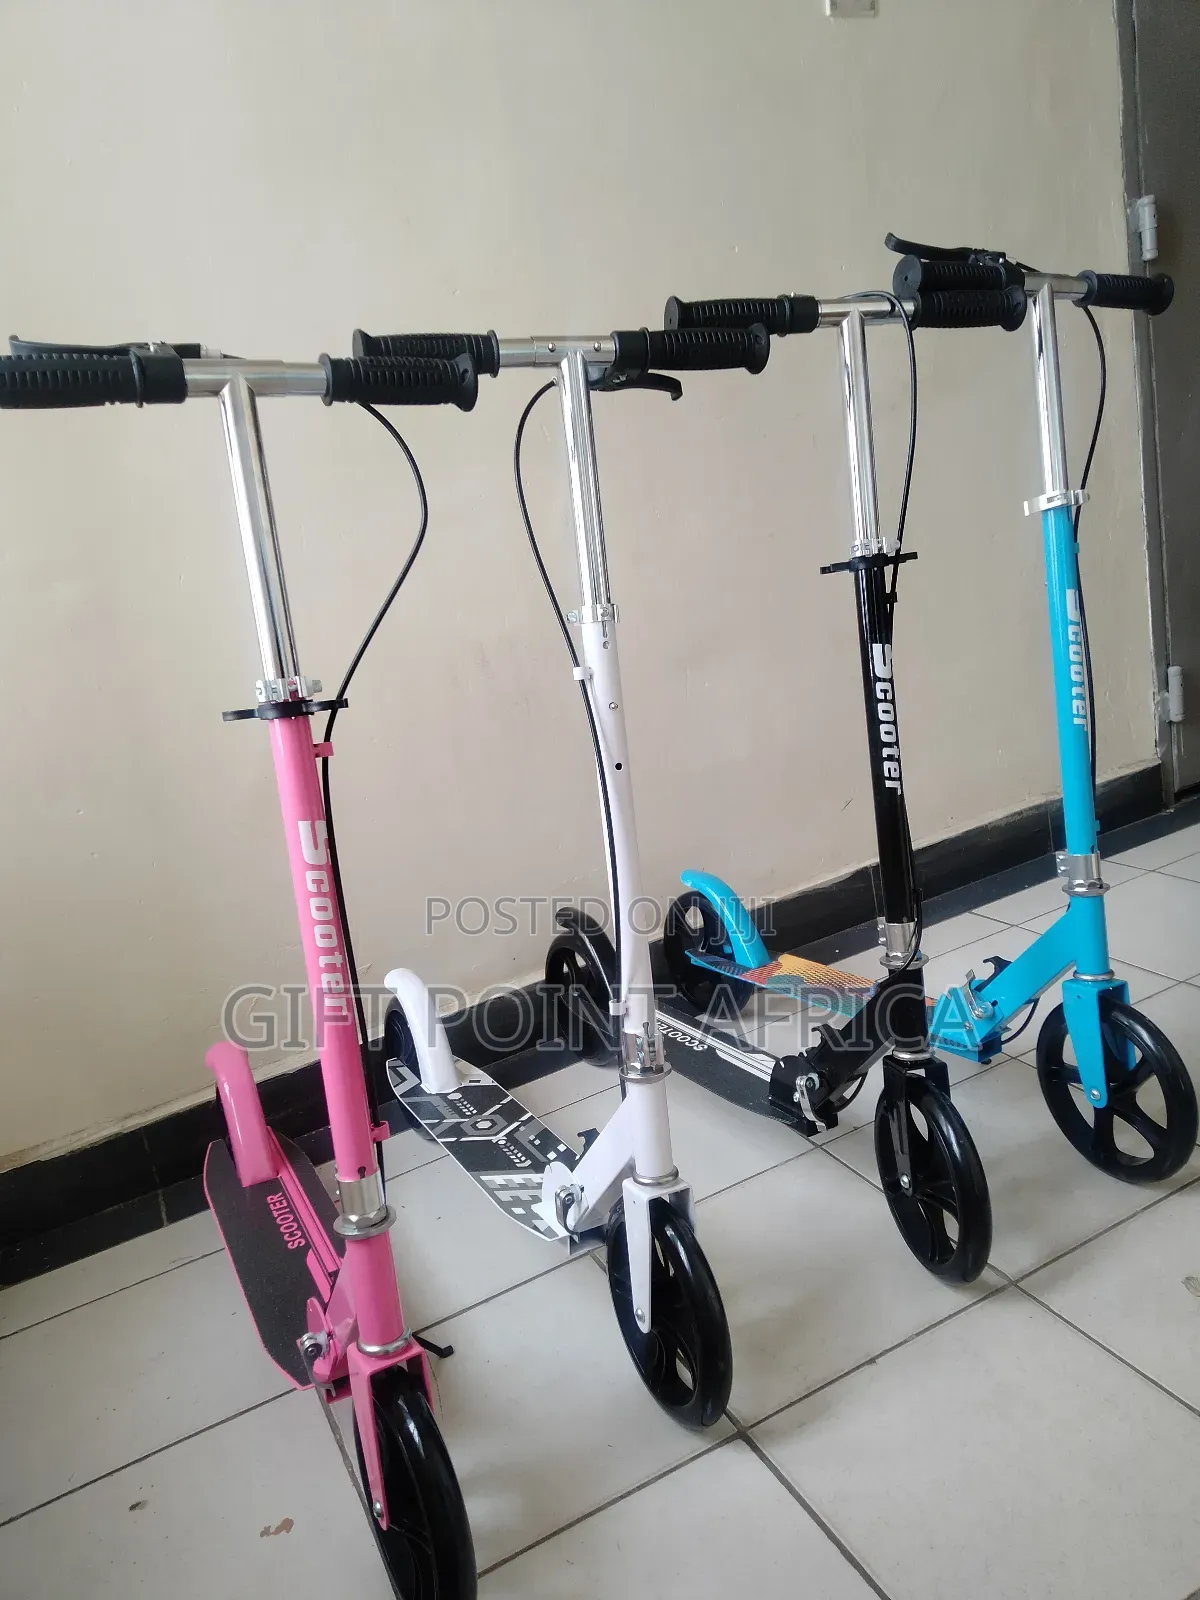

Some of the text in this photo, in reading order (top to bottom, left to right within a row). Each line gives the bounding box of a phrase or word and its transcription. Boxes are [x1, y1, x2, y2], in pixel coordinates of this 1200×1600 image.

[872, 643, 902, 795] Scooter
[298, 820, 348, 1015] Scooter
[656, 1021, 708, 1051] SCOOTE
[266, 1191, 306, 1250] SCOOTER
